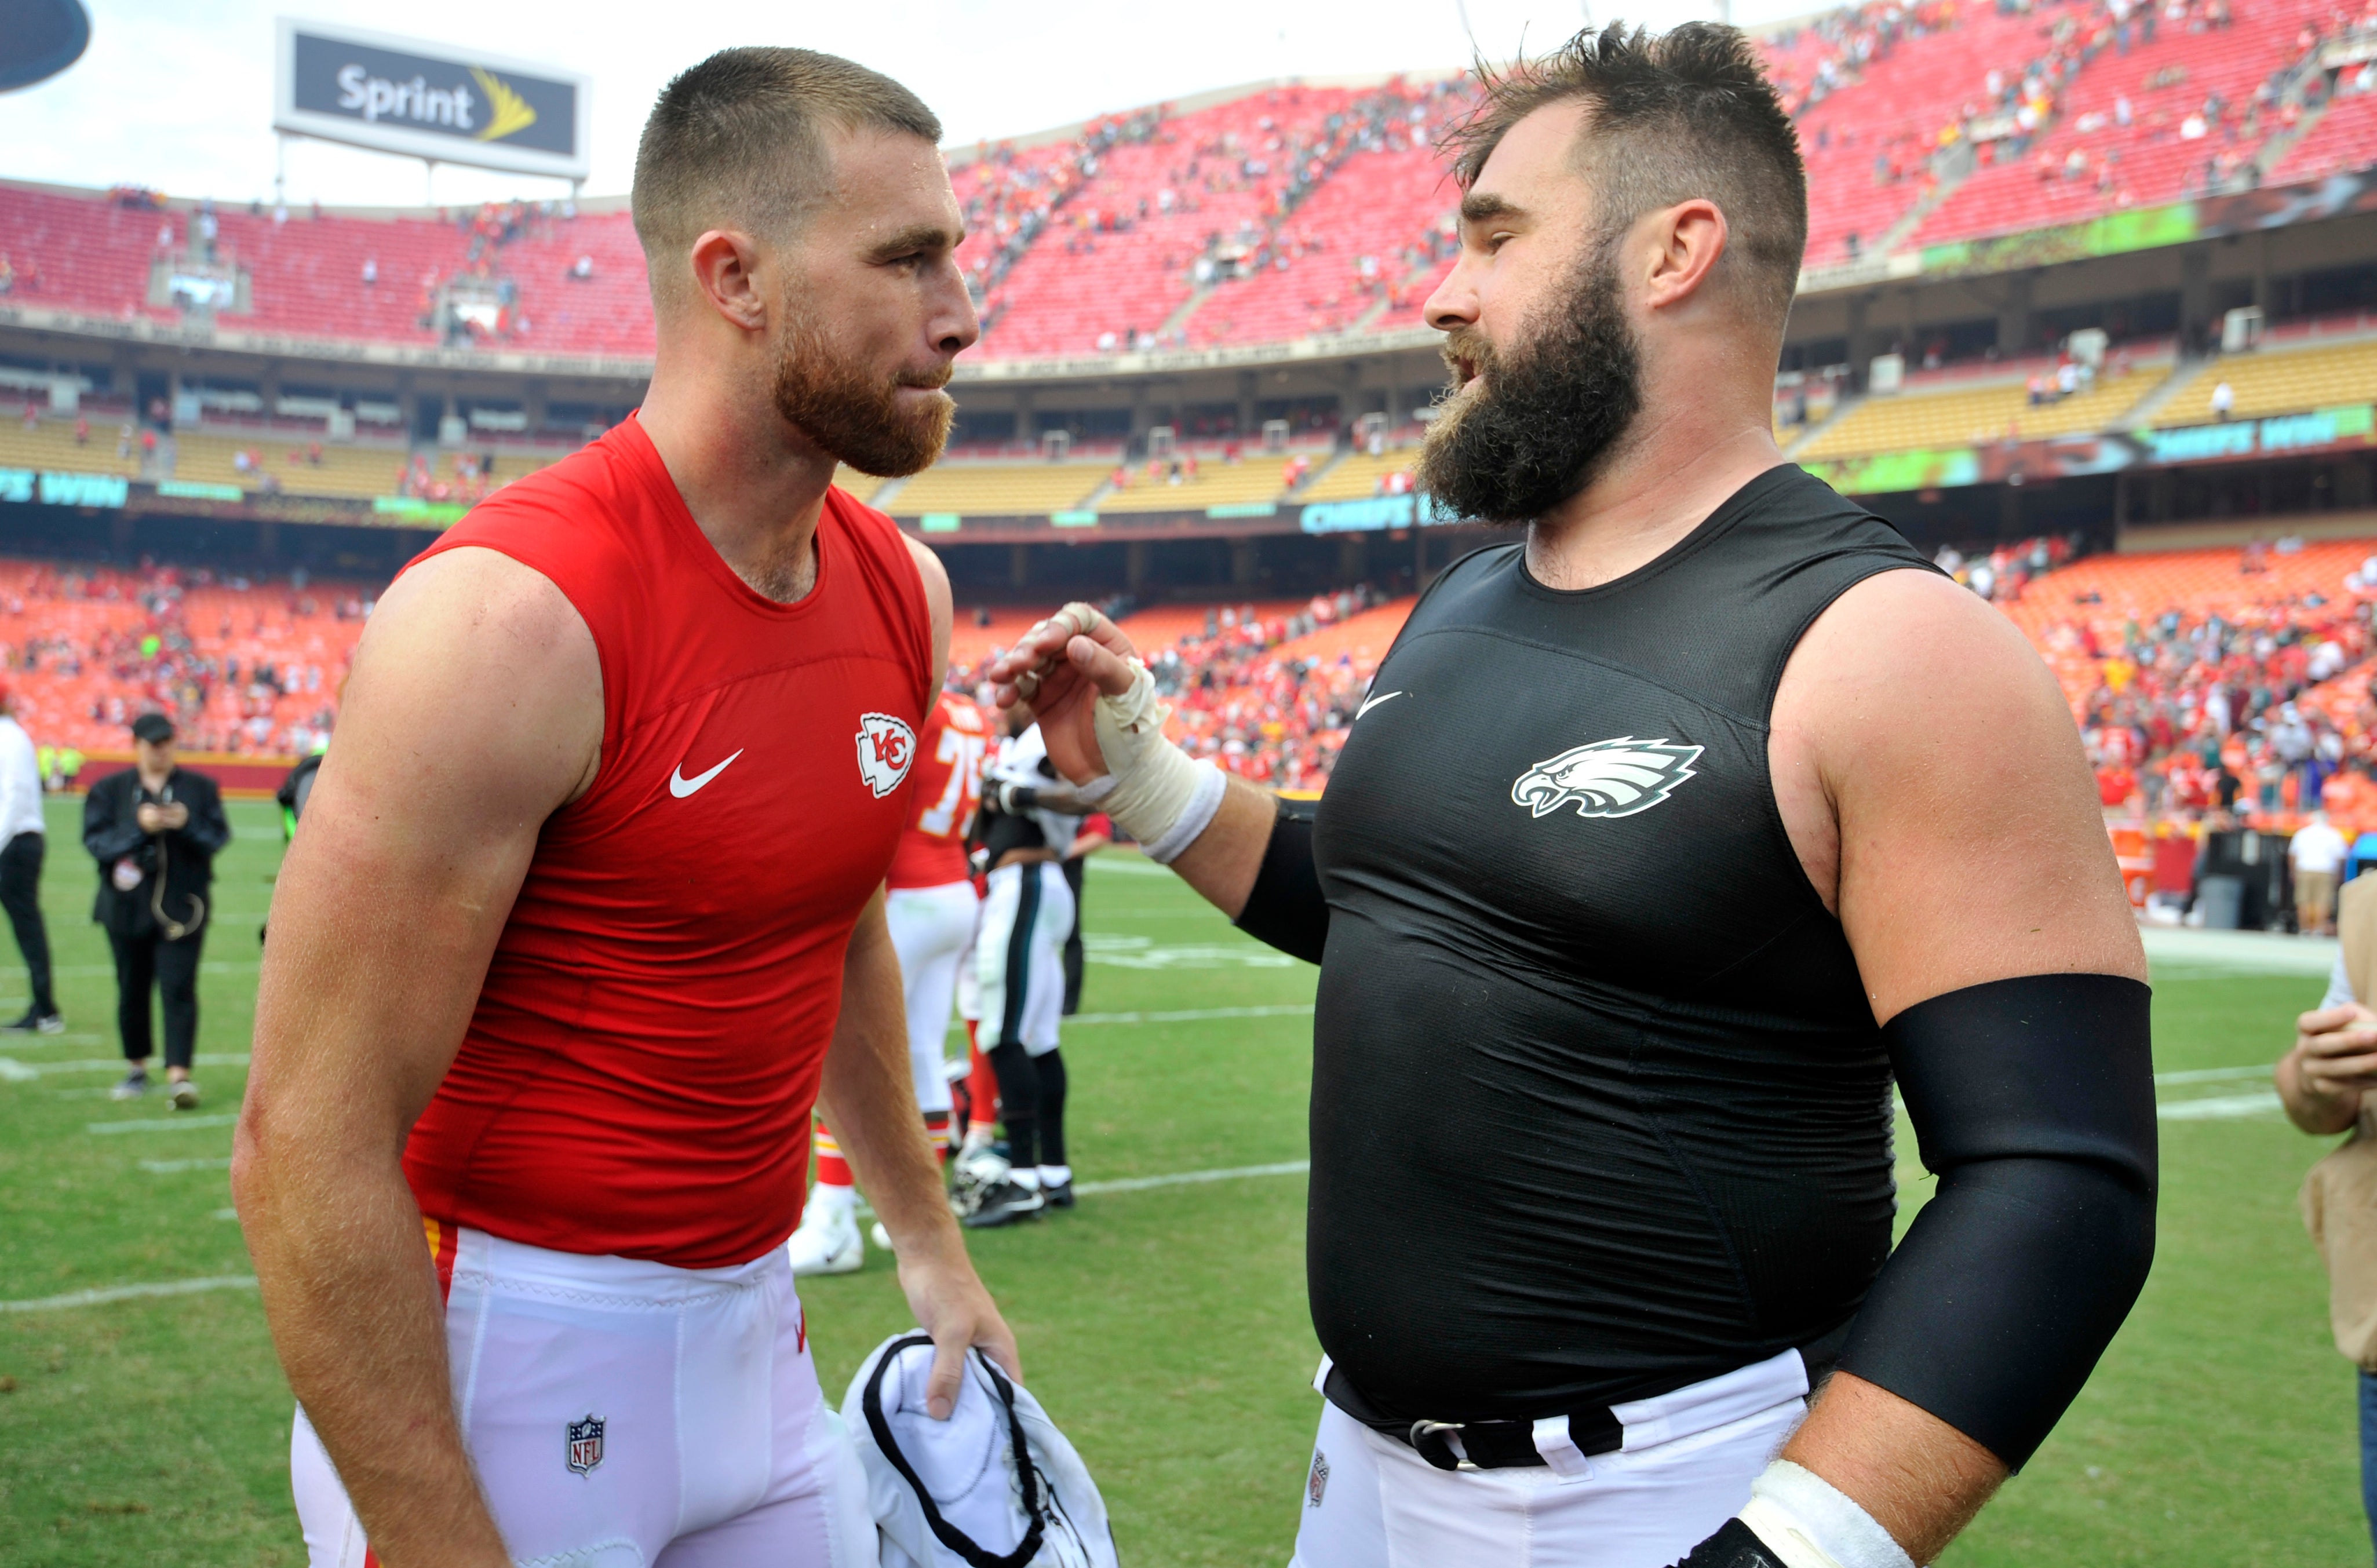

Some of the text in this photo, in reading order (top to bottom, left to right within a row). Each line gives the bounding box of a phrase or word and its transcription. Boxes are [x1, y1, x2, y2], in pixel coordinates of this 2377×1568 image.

[337, 63, 475, 130] Sprint
[872, 728, 907, 770] KC
[573, 1440, 599, 1465] NFL
